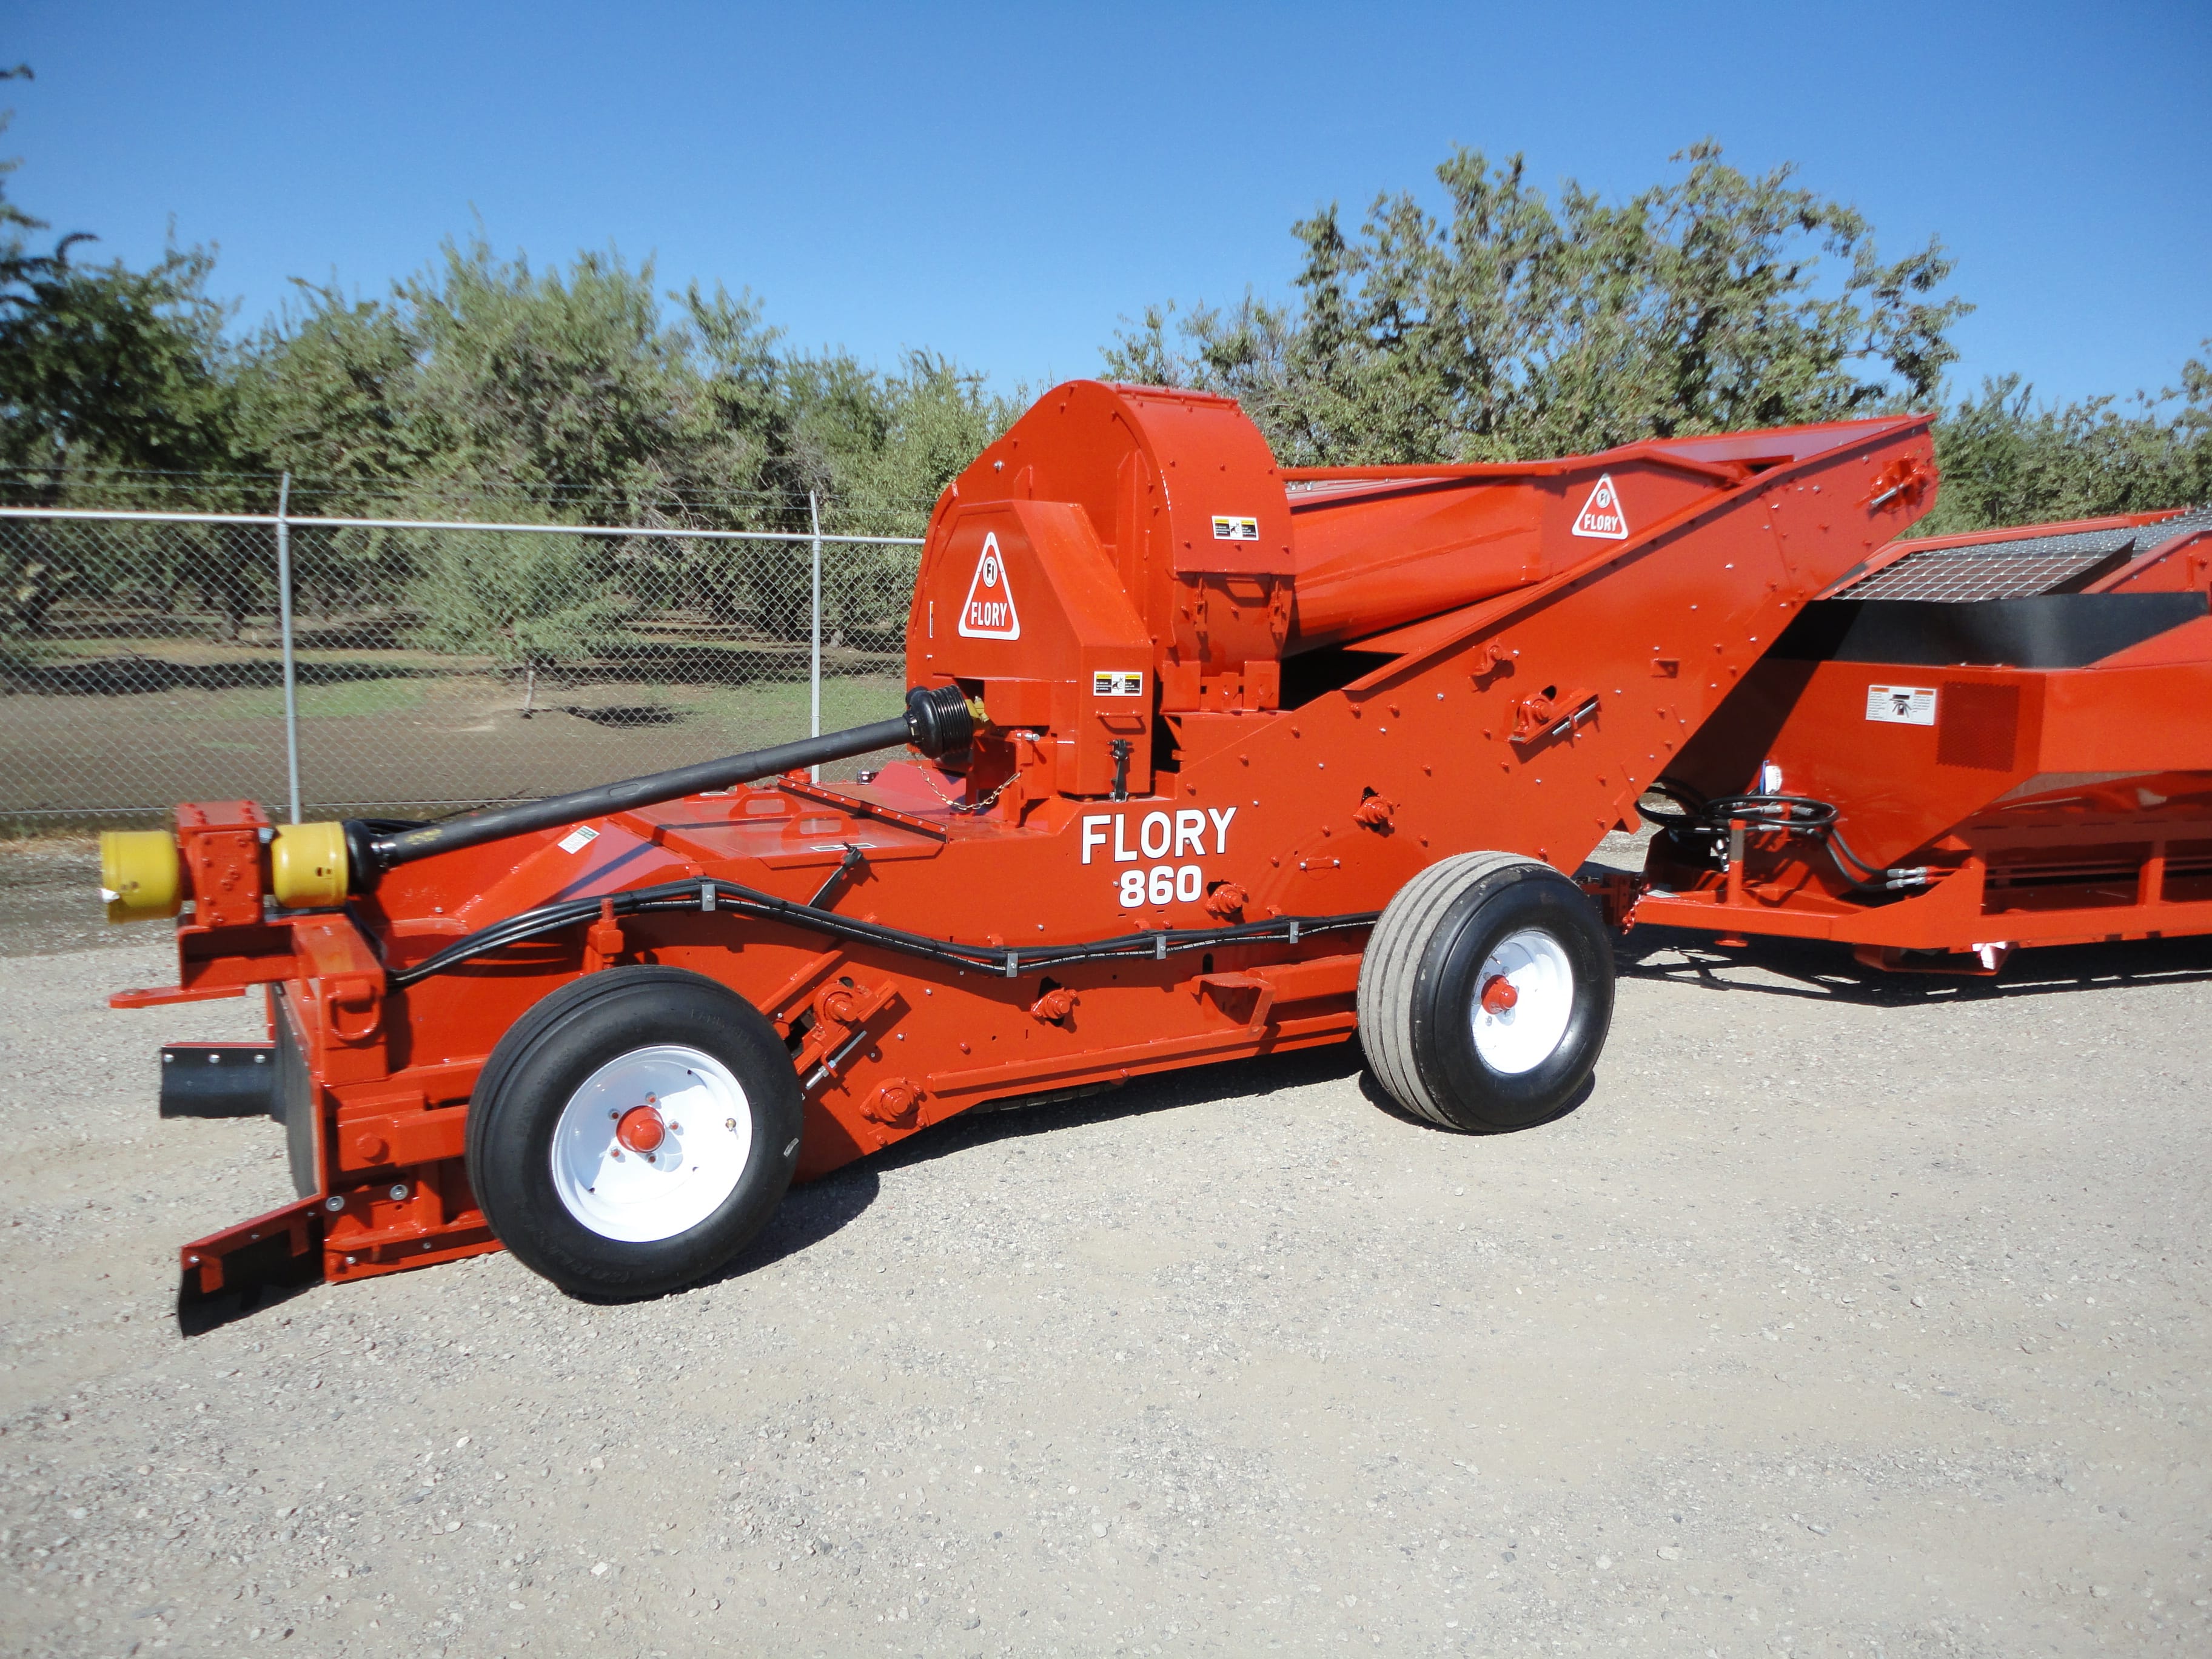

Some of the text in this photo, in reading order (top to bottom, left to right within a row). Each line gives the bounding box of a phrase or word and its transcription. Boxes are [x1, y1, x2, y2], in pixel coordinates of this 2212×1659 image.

[1584, 514, 1618, 532] FLORY
[987, 563, 994, 580] FI
[971, 602, 1008, 627] FLORY
[1081, 806, 1238, 865] FLORY
[1119, 865, 1202, 908] 860
